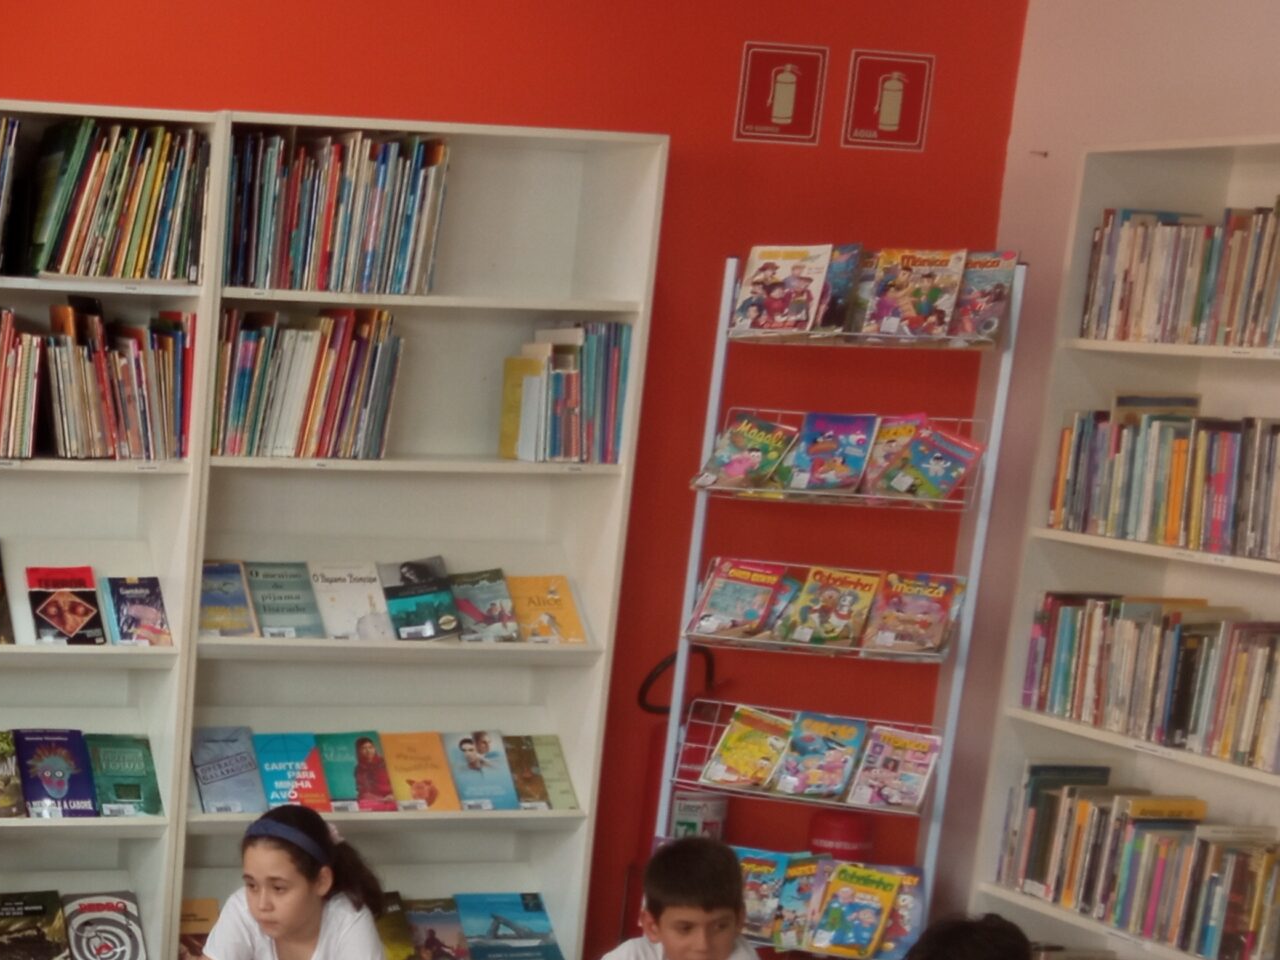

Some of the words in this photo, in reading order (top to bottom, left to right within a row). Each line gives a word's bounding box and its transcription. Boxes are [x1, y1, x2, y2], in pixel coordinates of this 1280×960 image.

[736, 419, 784, 448] Magali
[250, 570, 259, 578] O
[312, 574, 319, 583] O
[813, 570, 873, 592] Cebolinha
[261, 592, 301, 603] pijama
[527, 595, 562, 607] Alice
[264, 761, 308, 771] CARTAS
[287, 771, 316, 779] PARA
[274, 780, 312, 789] MINHA
